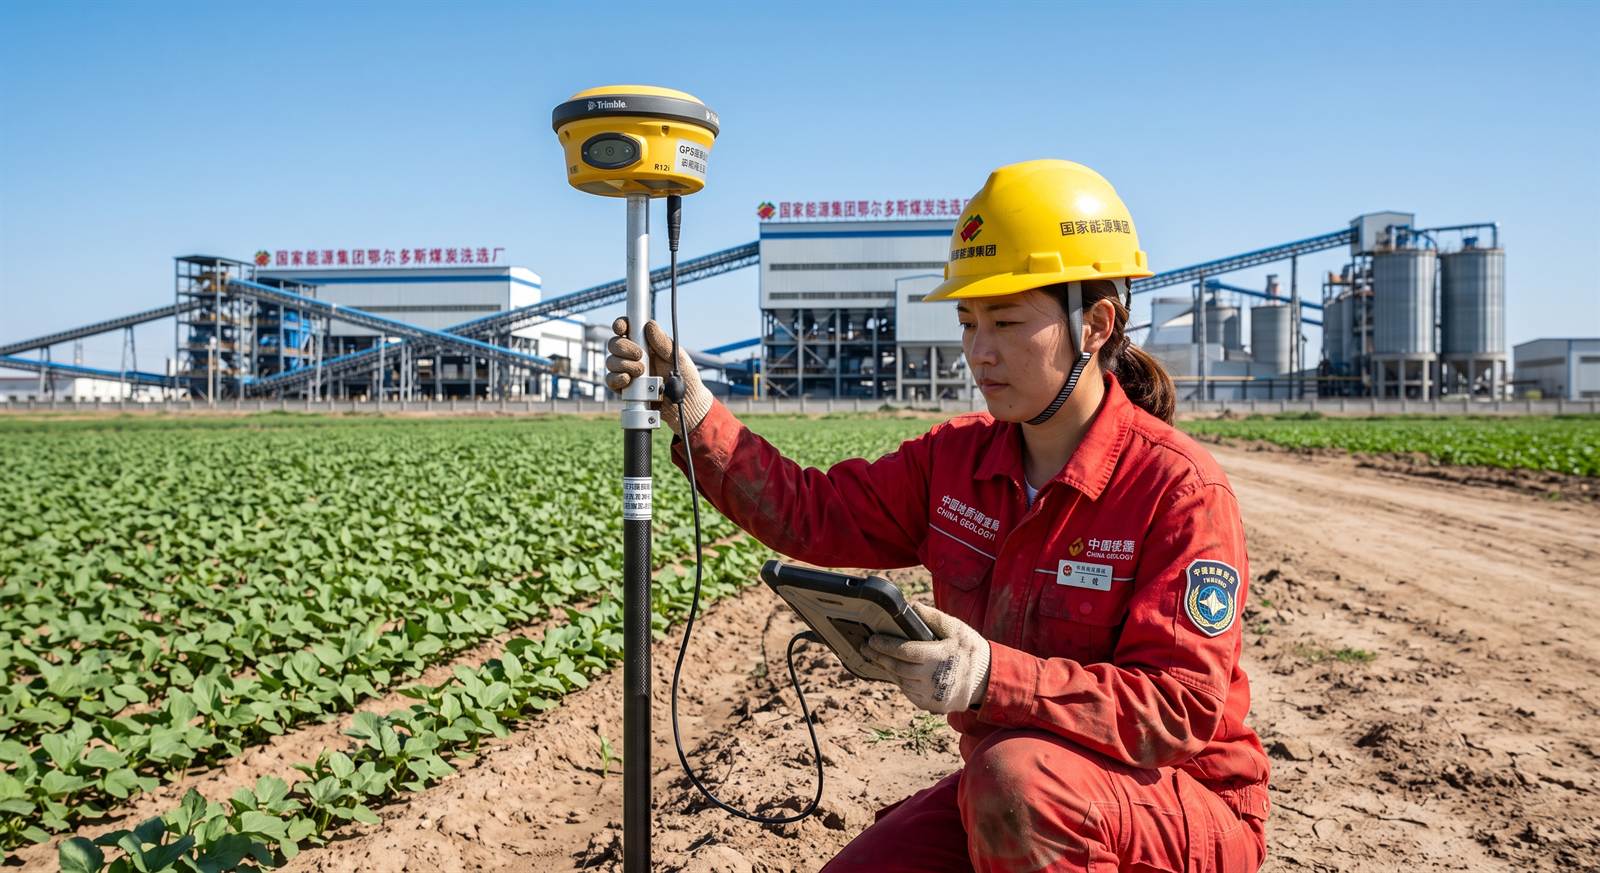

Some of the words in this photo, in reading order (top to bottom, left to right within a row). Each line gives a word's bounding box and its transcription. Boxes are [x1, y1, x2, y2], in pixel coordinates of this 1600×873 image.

[597, 100, 628, 110] Trimble
[779, 198, 969, 218] 国家能源集团鄂尔多斯煤炭洗选
[1060, 219, 1131, 236] 国家能源集团
[275, 247, 505, 266] 国家能源集团鄂尔多斯煤炭洗选厂
[936, 506, 958, 523] CHINA
[1086, 551, 1105, 559] CHINA
